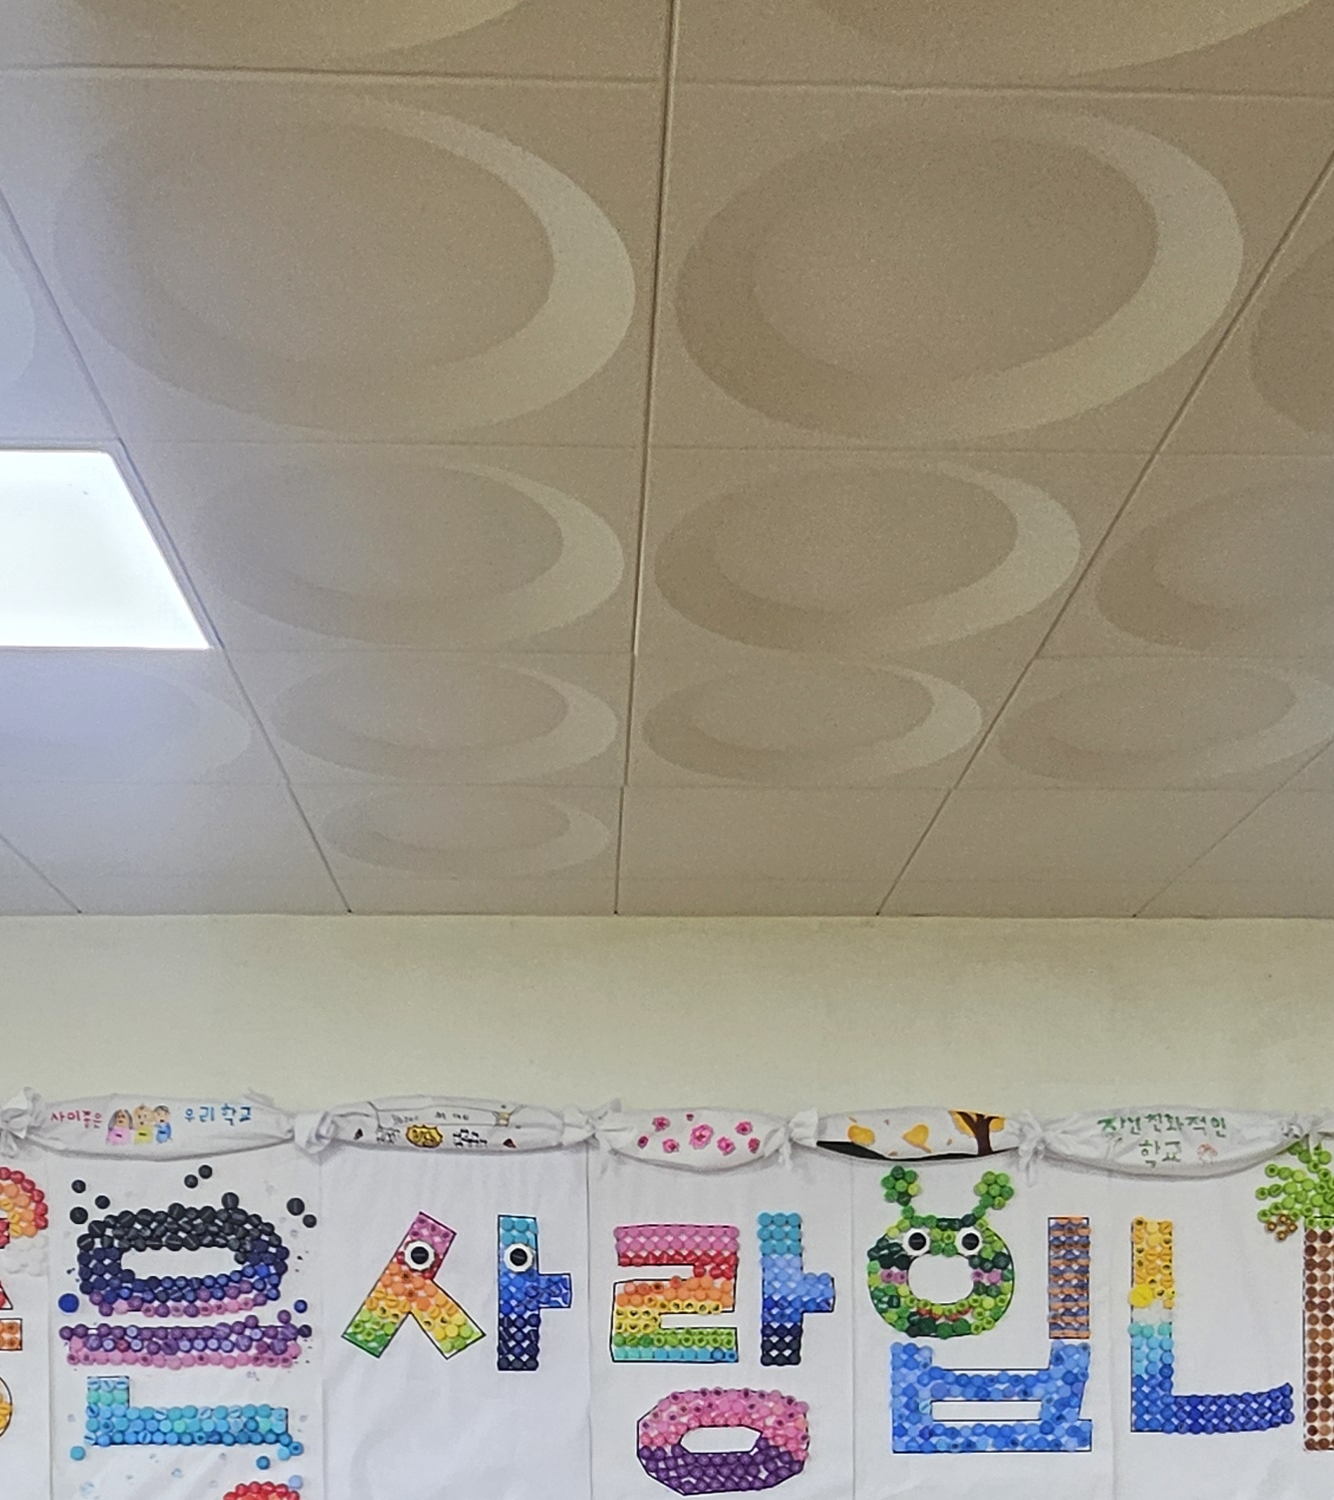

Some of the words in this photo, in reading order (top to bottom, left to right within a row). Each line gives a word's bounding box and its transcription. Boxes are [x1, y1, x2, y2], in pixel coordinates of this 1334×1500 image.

[184, 1105, 216, 1124] 우리
[220, 1103, 253, 1127] 학교
[1138, 1139, 1183, 1169] 학교
